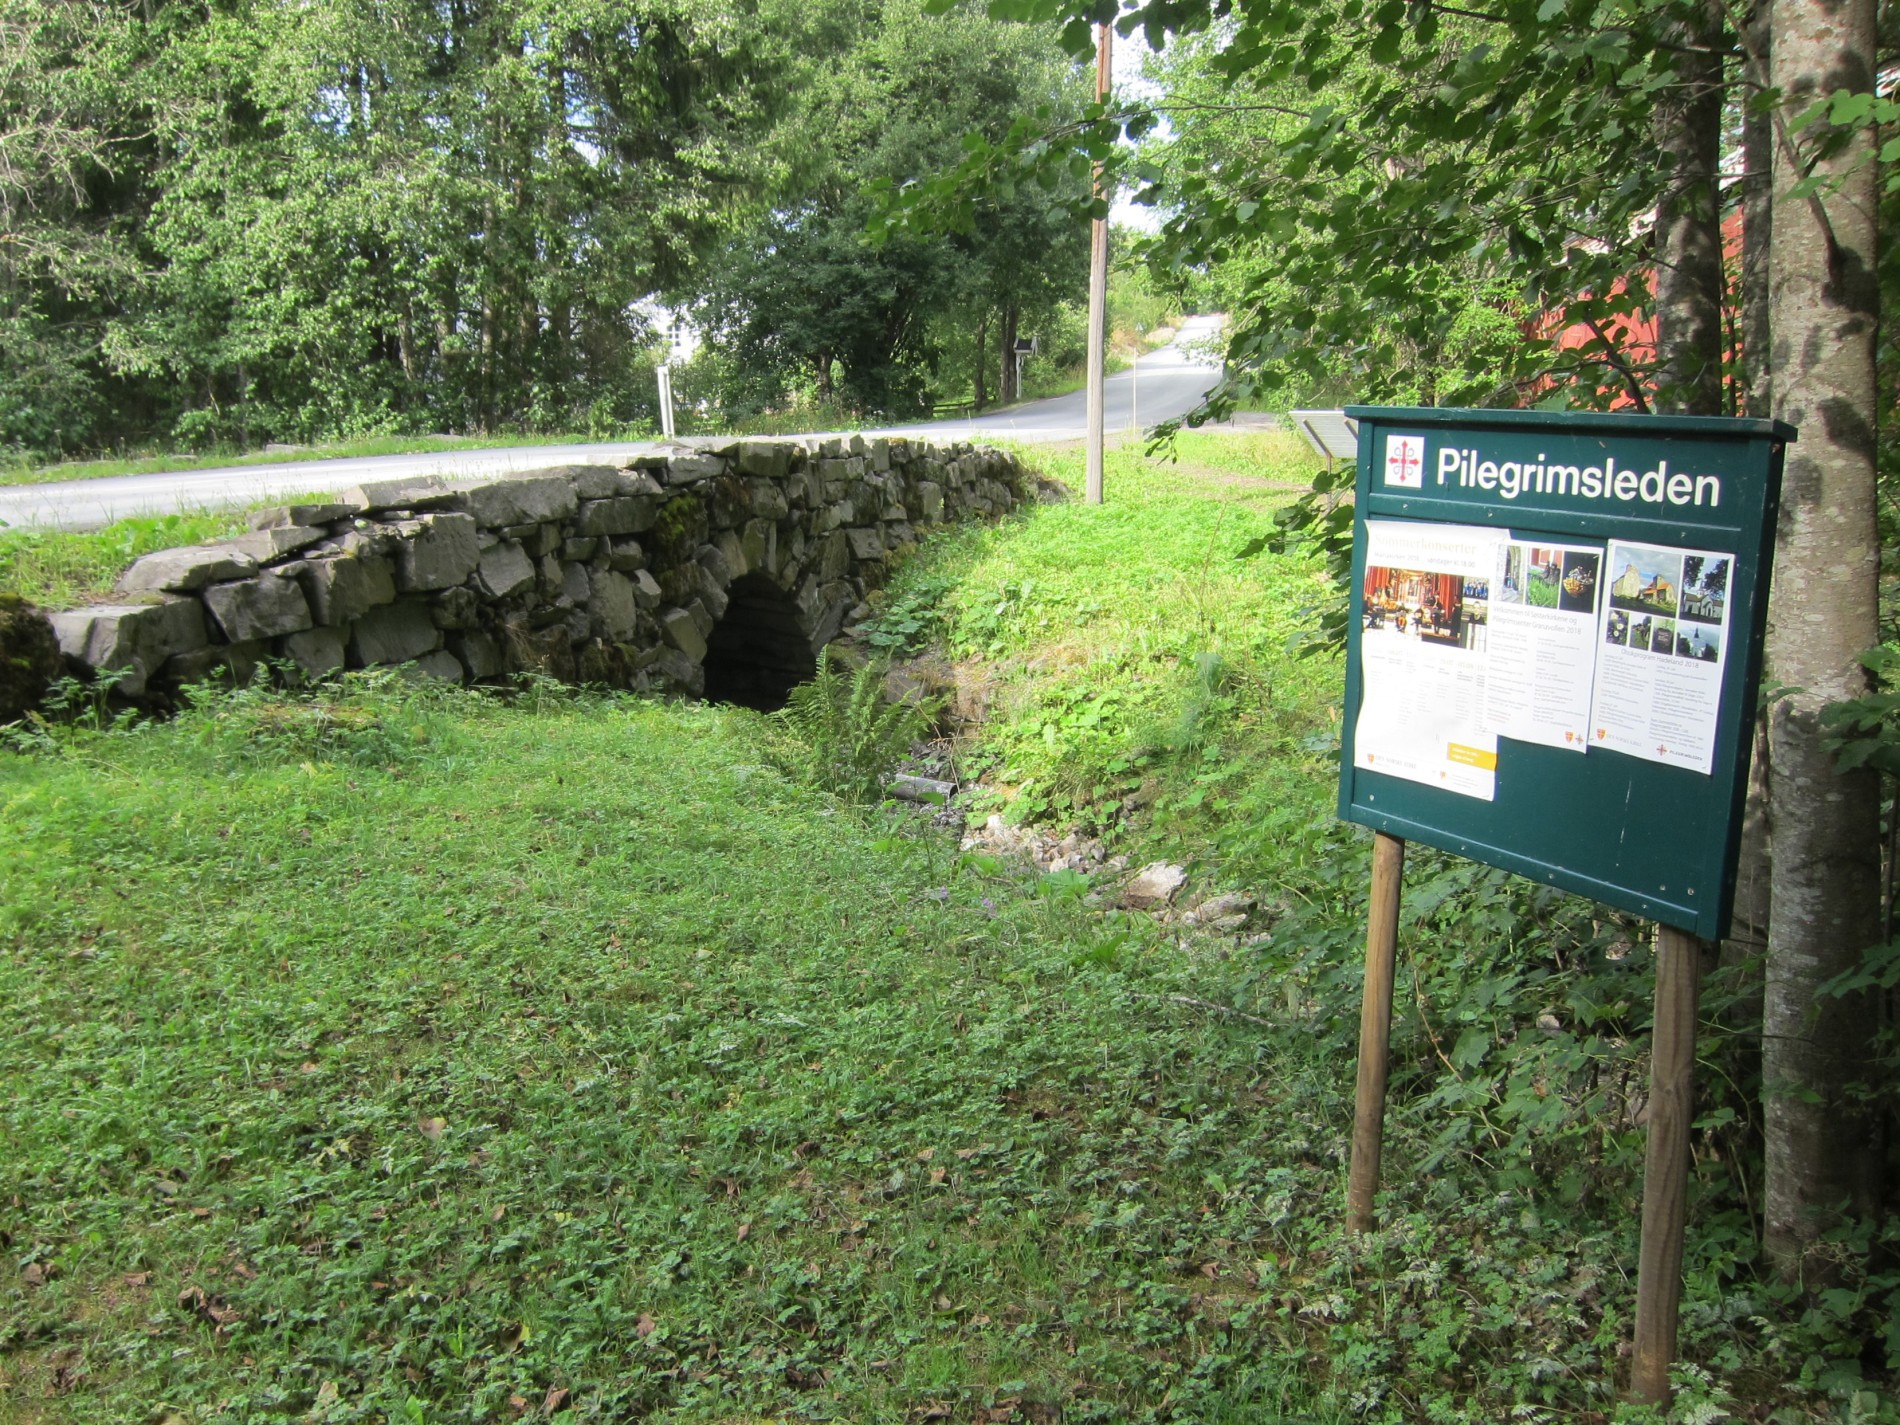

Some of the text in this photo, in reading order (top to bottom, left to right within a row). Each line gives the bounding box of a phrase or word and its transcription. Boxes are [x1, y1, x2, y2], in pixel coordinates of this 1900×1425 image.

[1438, 447, 1720, 507] Pilegrimsleden
[1566, 627, 1582, 635] 2018
[1657, 656, 1684, 666] Hadeland
[1684, 661, 1700, 669] 2018
